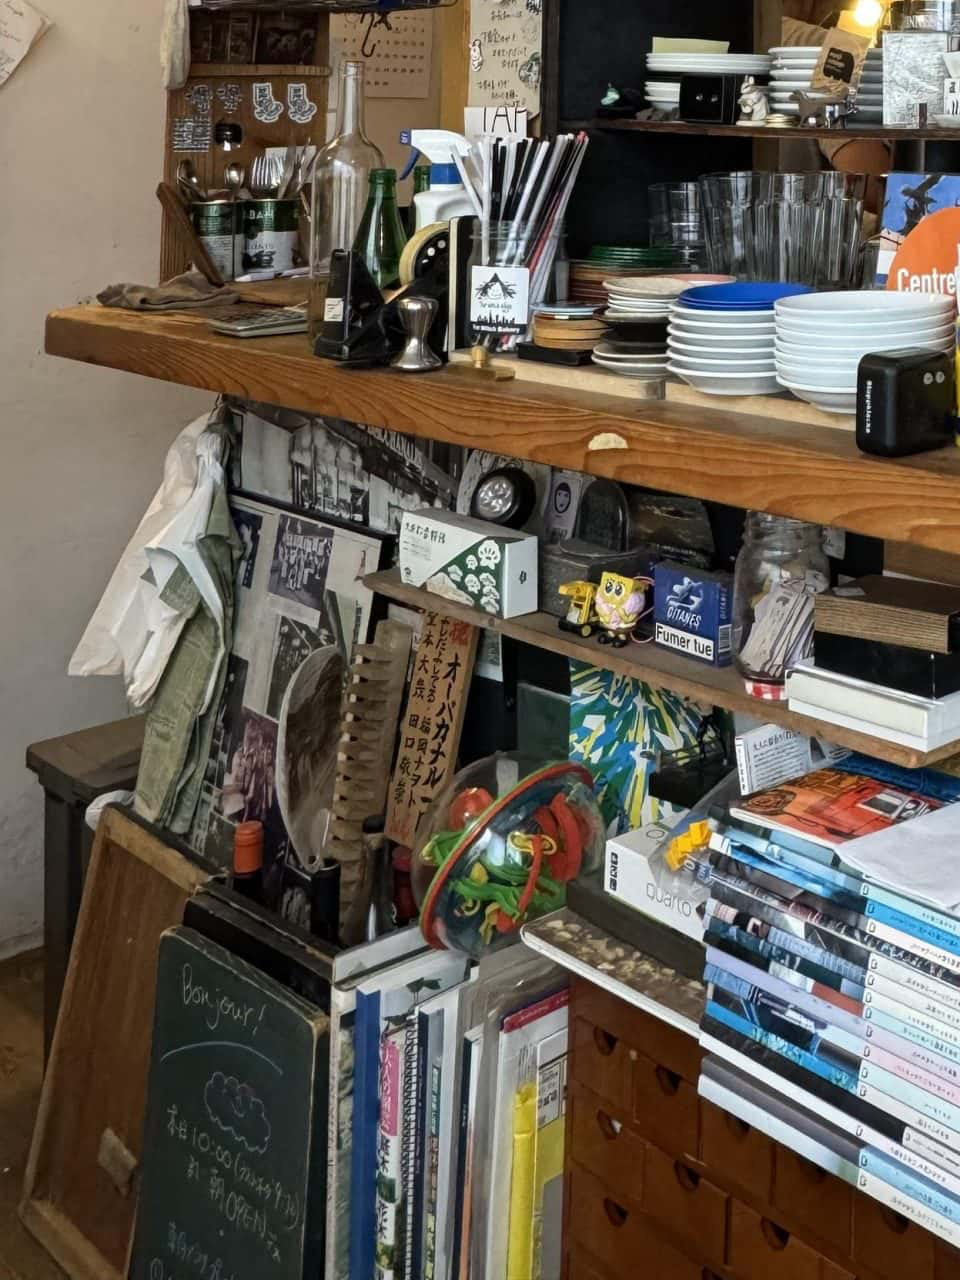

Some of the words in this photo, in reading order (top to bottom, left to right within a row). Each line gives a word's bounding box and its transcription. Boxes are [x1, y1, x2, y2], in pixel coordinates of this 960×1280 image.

[667, 606, 702, 630] GITANES
[656, 625, 690, 649] Fumer
[694, 638, 713, 657] tue
[182, 962, 266, 1036] Bonjour!
